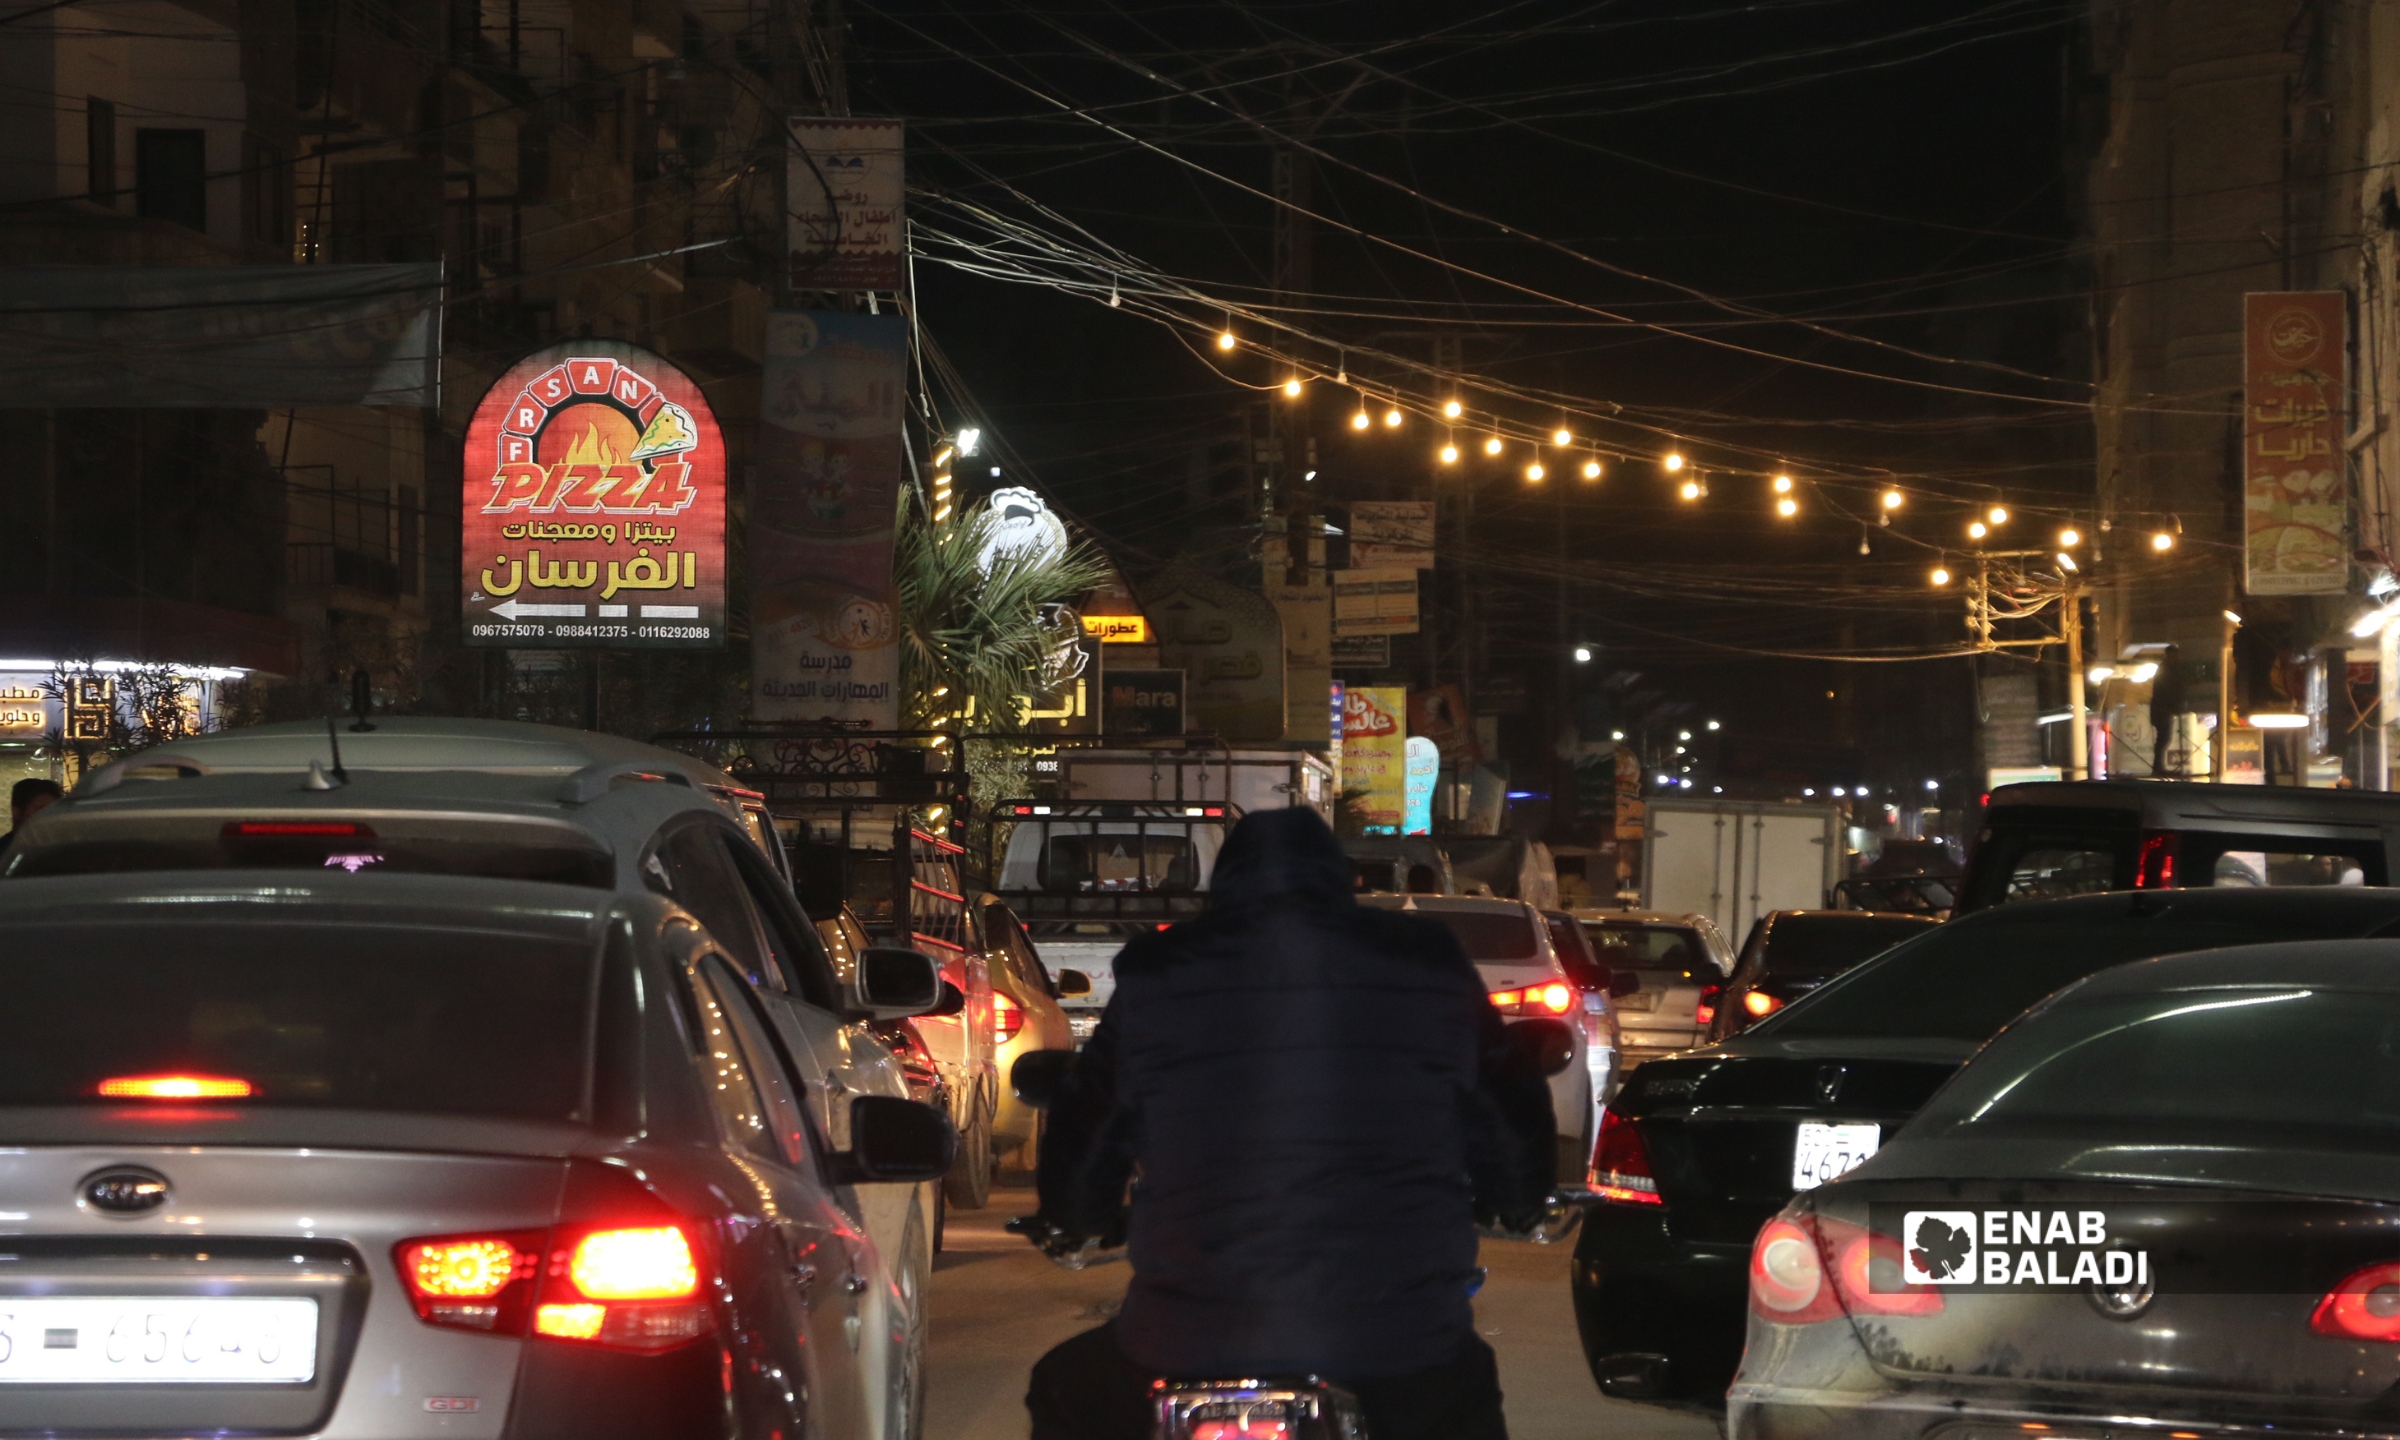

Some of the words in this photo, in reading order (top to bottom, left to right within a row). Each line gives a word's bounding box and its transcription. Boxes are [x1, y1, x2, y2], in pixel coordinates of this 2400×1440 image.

[482, 462, 698, 515] PIZZA
[502, 521, 617, 546] ومعجنات
[625, 521, 677, 546] بيتزا
[481, 548, 697, 602] الفرسان
[472, 625, 545, 638] 0967575078
[556, 626, 629, 638] 0988412375
[639, 626, 711, 640] 0116292088
[800, 651, 852, 675] مدرسة
[1112, 686, 1177, 709] Mara
